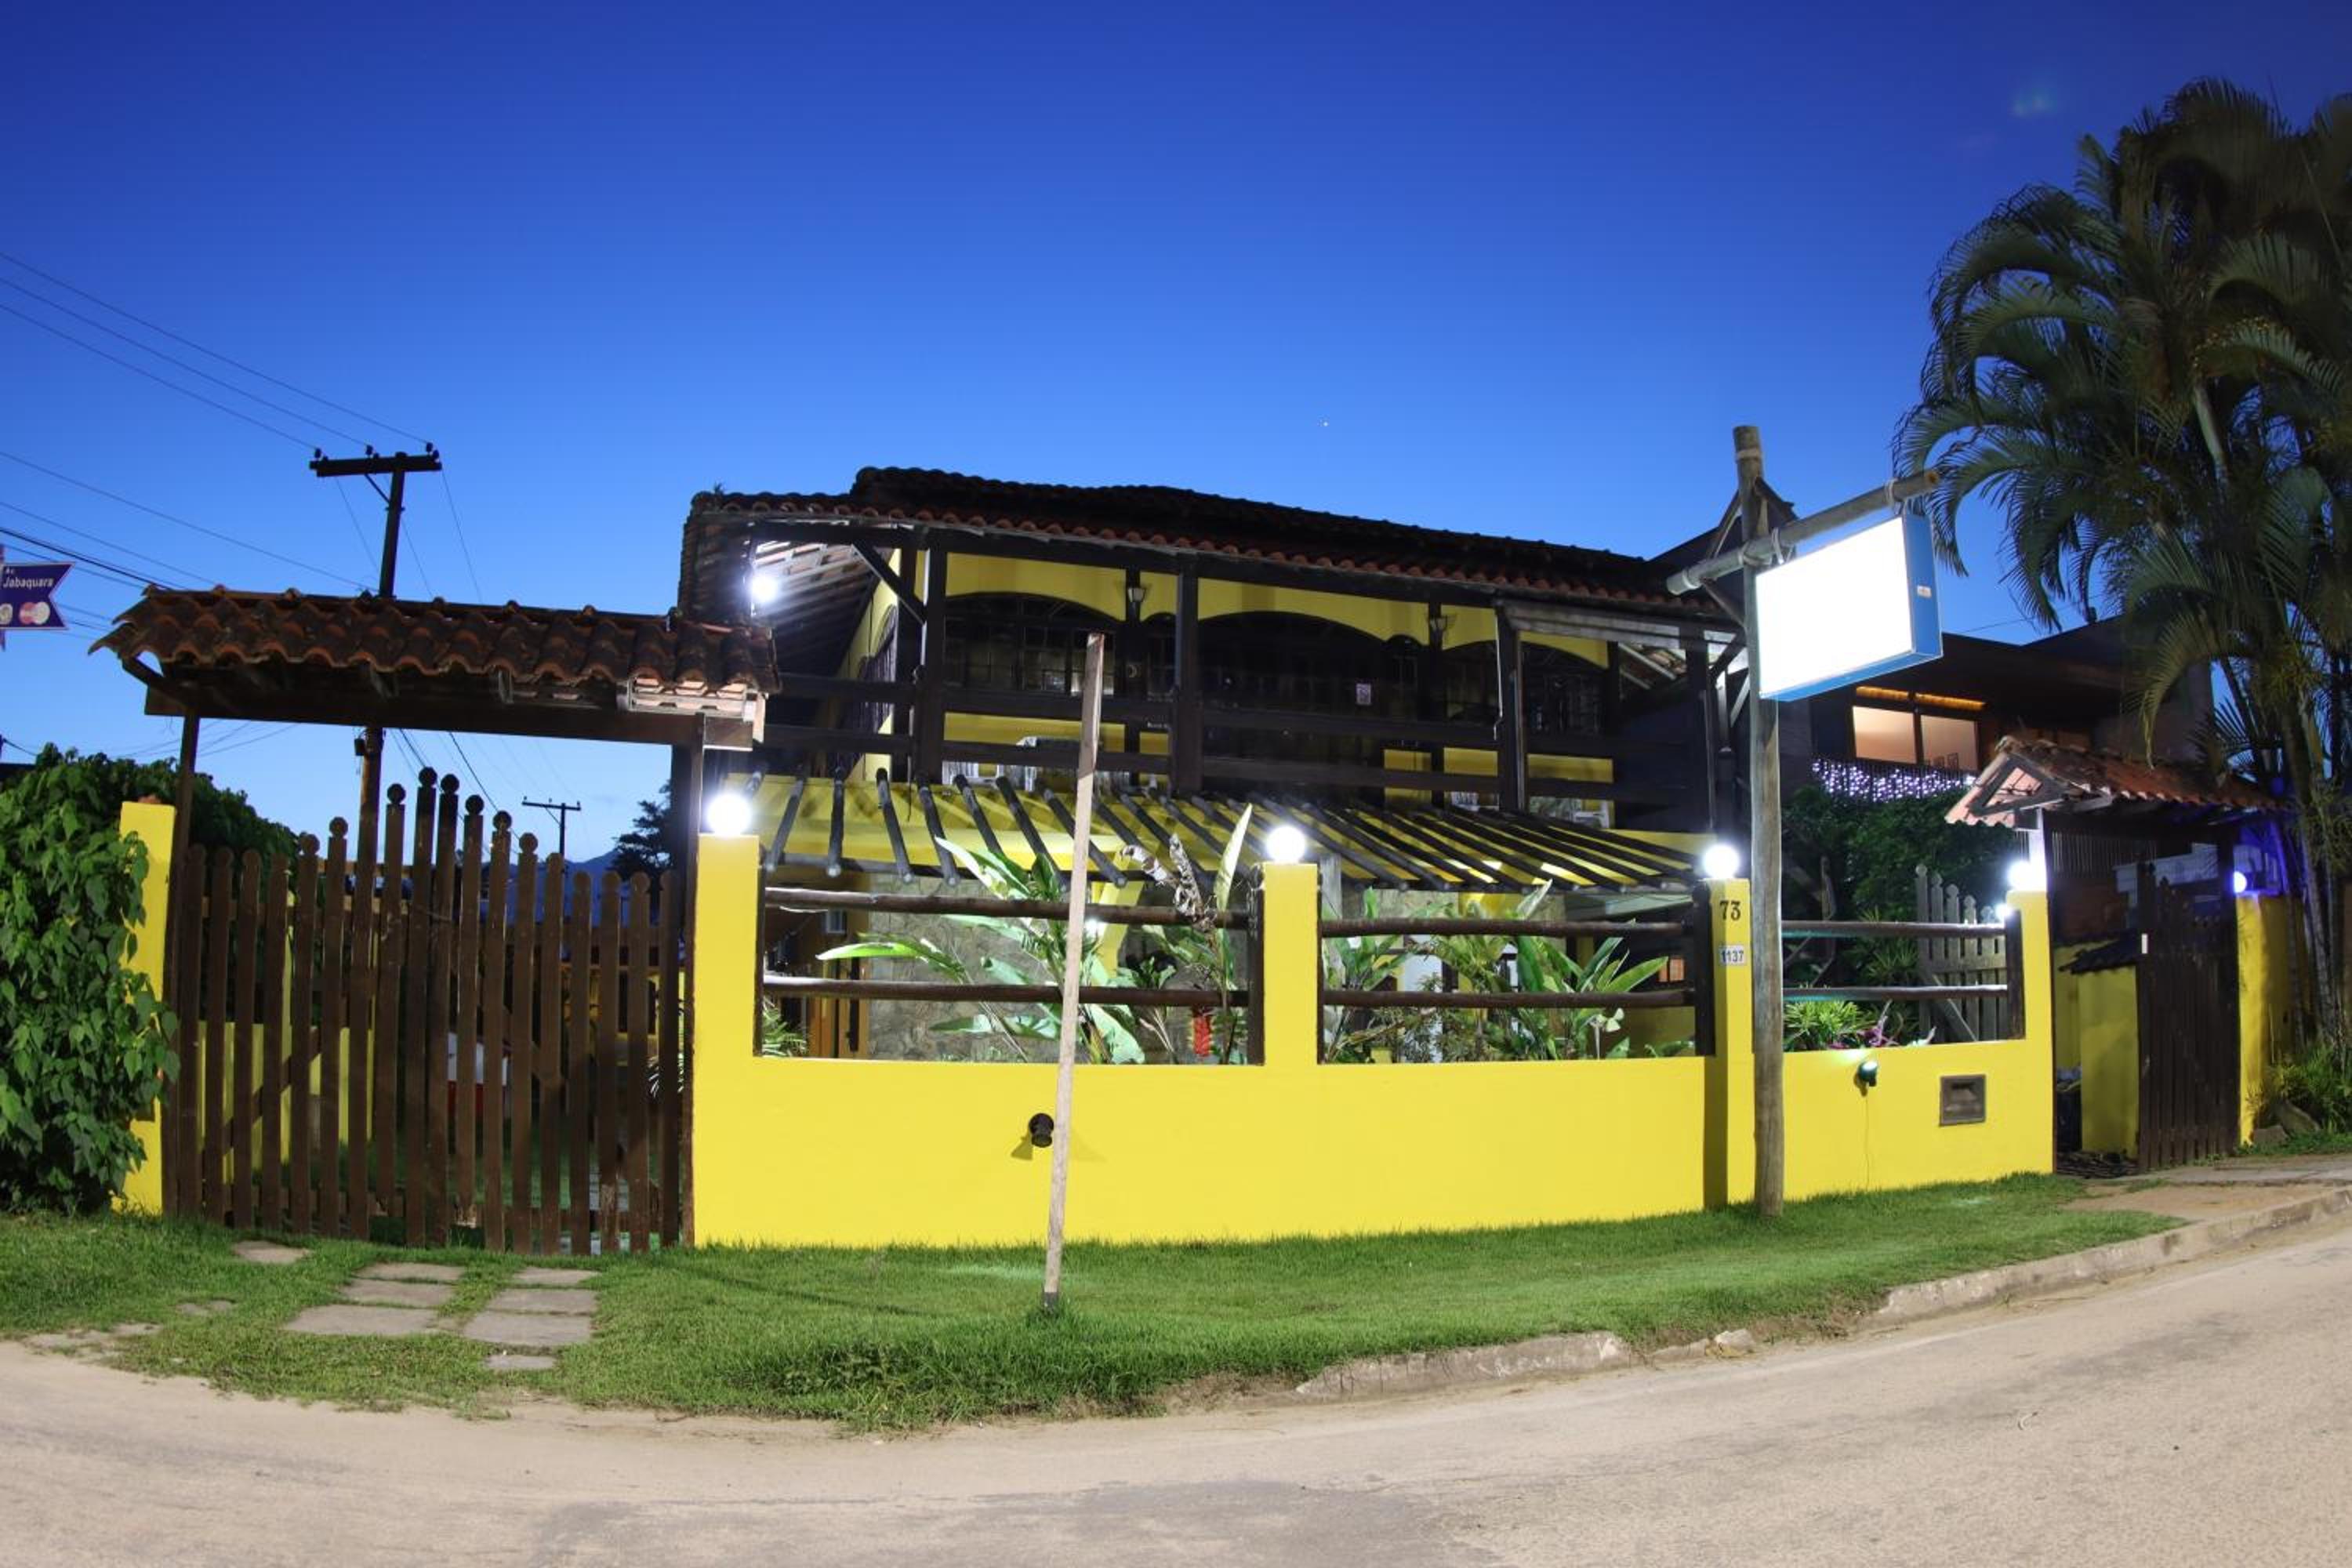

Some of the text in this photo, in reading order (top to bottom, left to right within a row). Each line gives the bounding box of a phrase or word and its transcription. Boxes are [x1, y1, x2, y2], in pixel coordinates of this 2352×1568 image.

[3, 577, 54, 589] Jabaquara
[1719, 900, 1741, 920] 73
[1721, 949, 1744, 963] 1137
